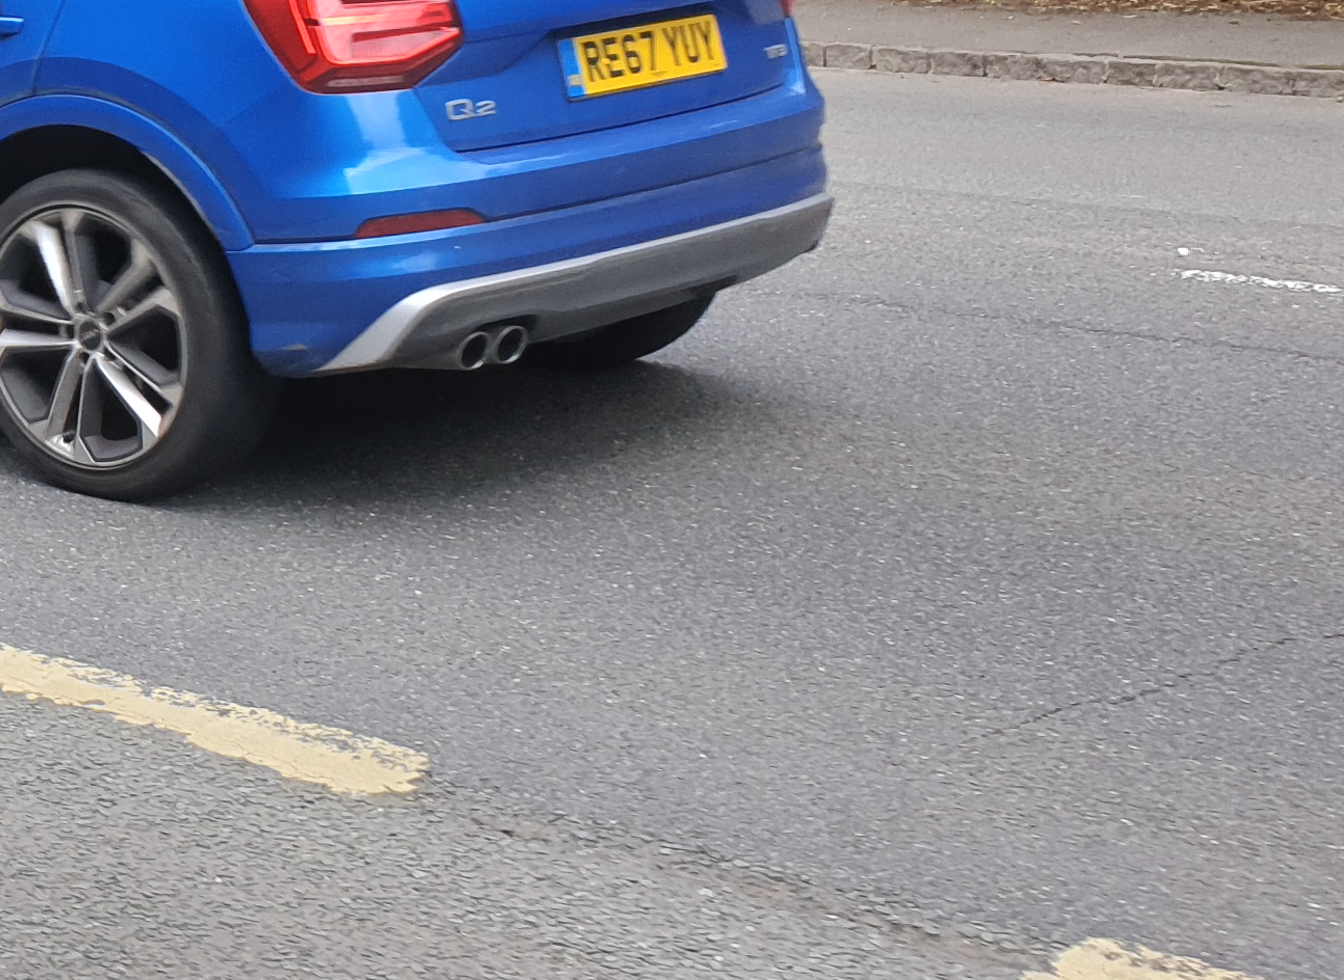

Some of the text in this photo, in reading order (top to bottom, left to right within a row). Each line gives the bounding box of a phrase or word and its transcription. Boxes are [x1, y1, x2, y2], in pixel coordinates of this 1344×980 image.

[580, 20, 716, 83] RE67 YUY
[444, 98, 497, 121] Q2
